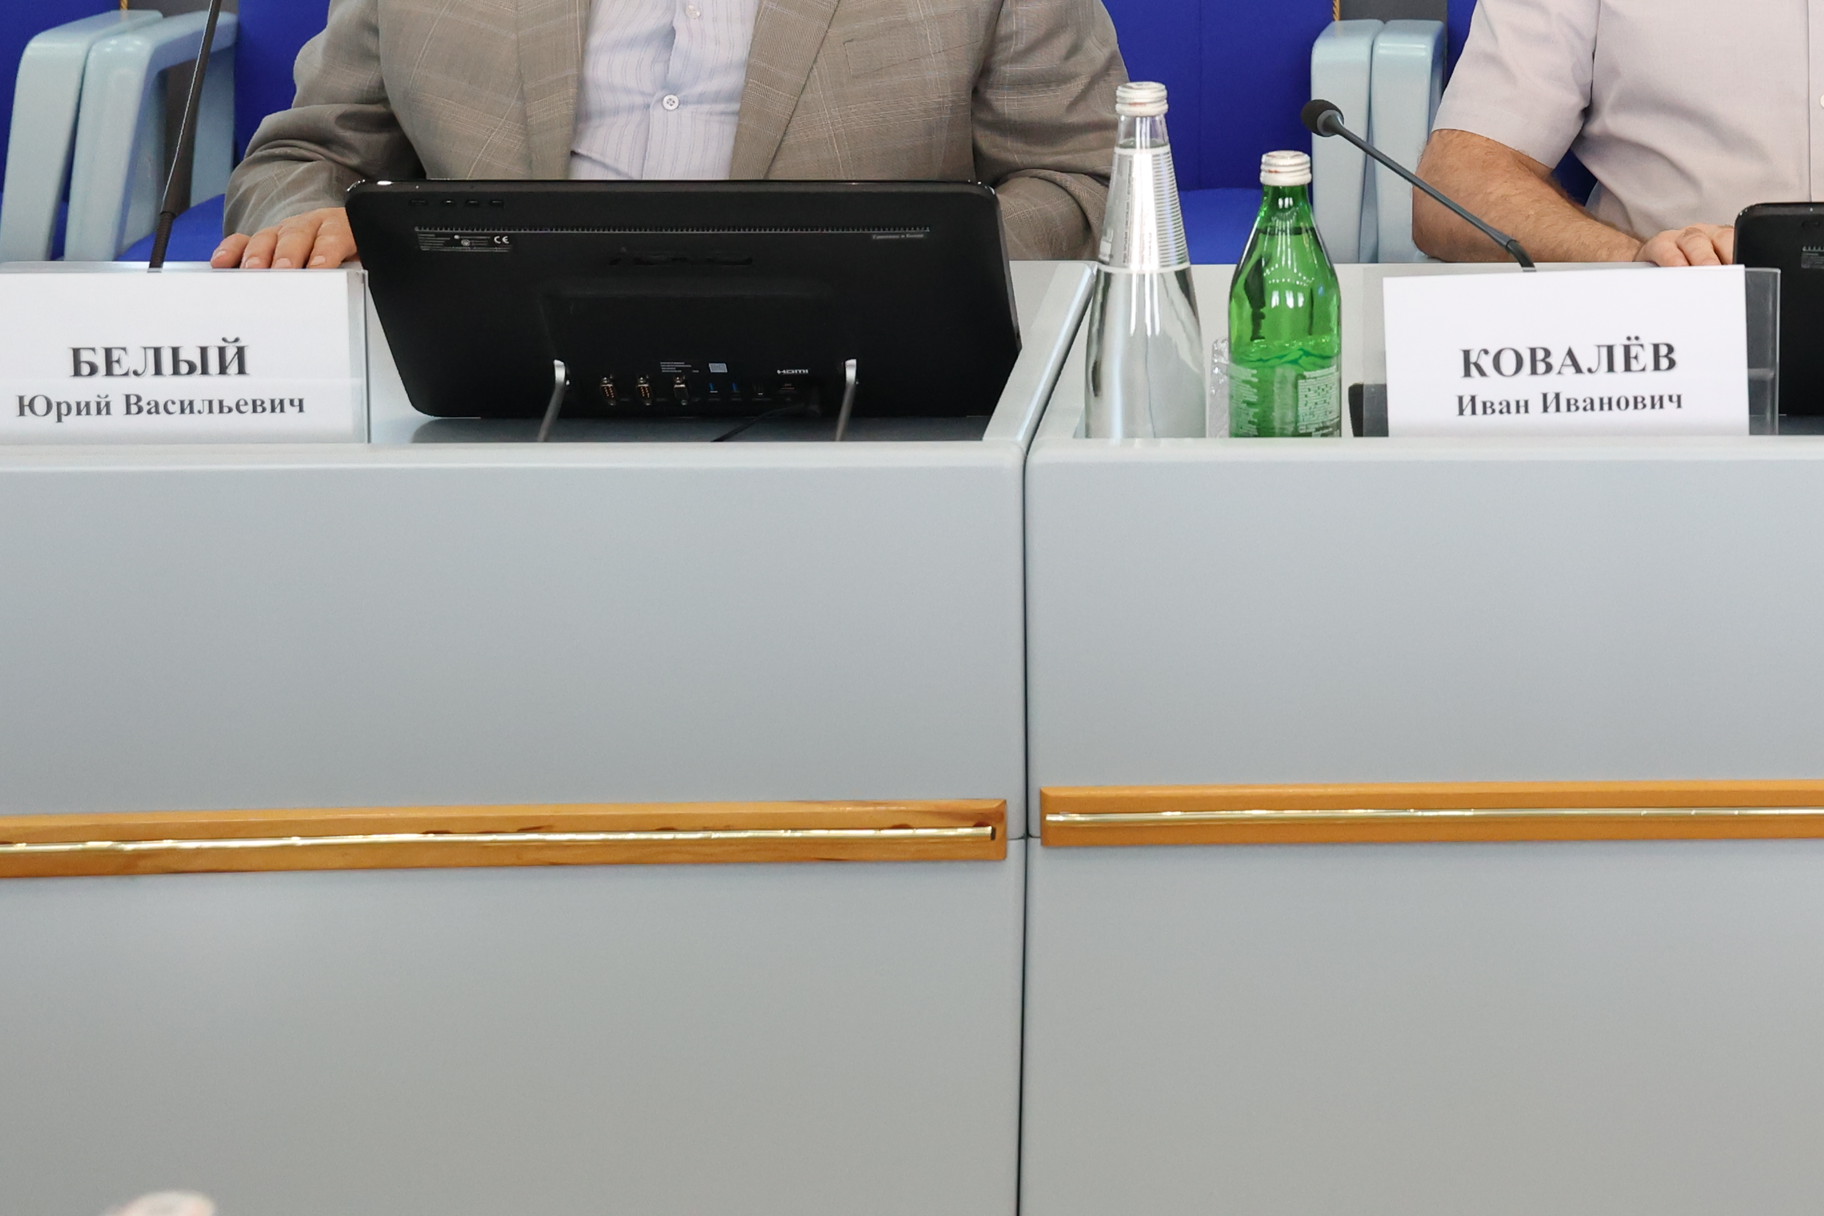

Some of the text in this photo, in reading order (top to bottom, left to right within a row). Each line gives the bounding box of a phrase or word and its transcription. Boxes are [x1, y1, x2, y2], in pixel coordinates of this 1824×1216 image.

[68, 336, 250, 378] БЕЛЫЙ
[1459, 335, 1677, 379] КОВАЛЁВ
[16, 393, 306, 423] Юрий Васильевич
[1456, 391, 1683, 417] Иван Иванович
